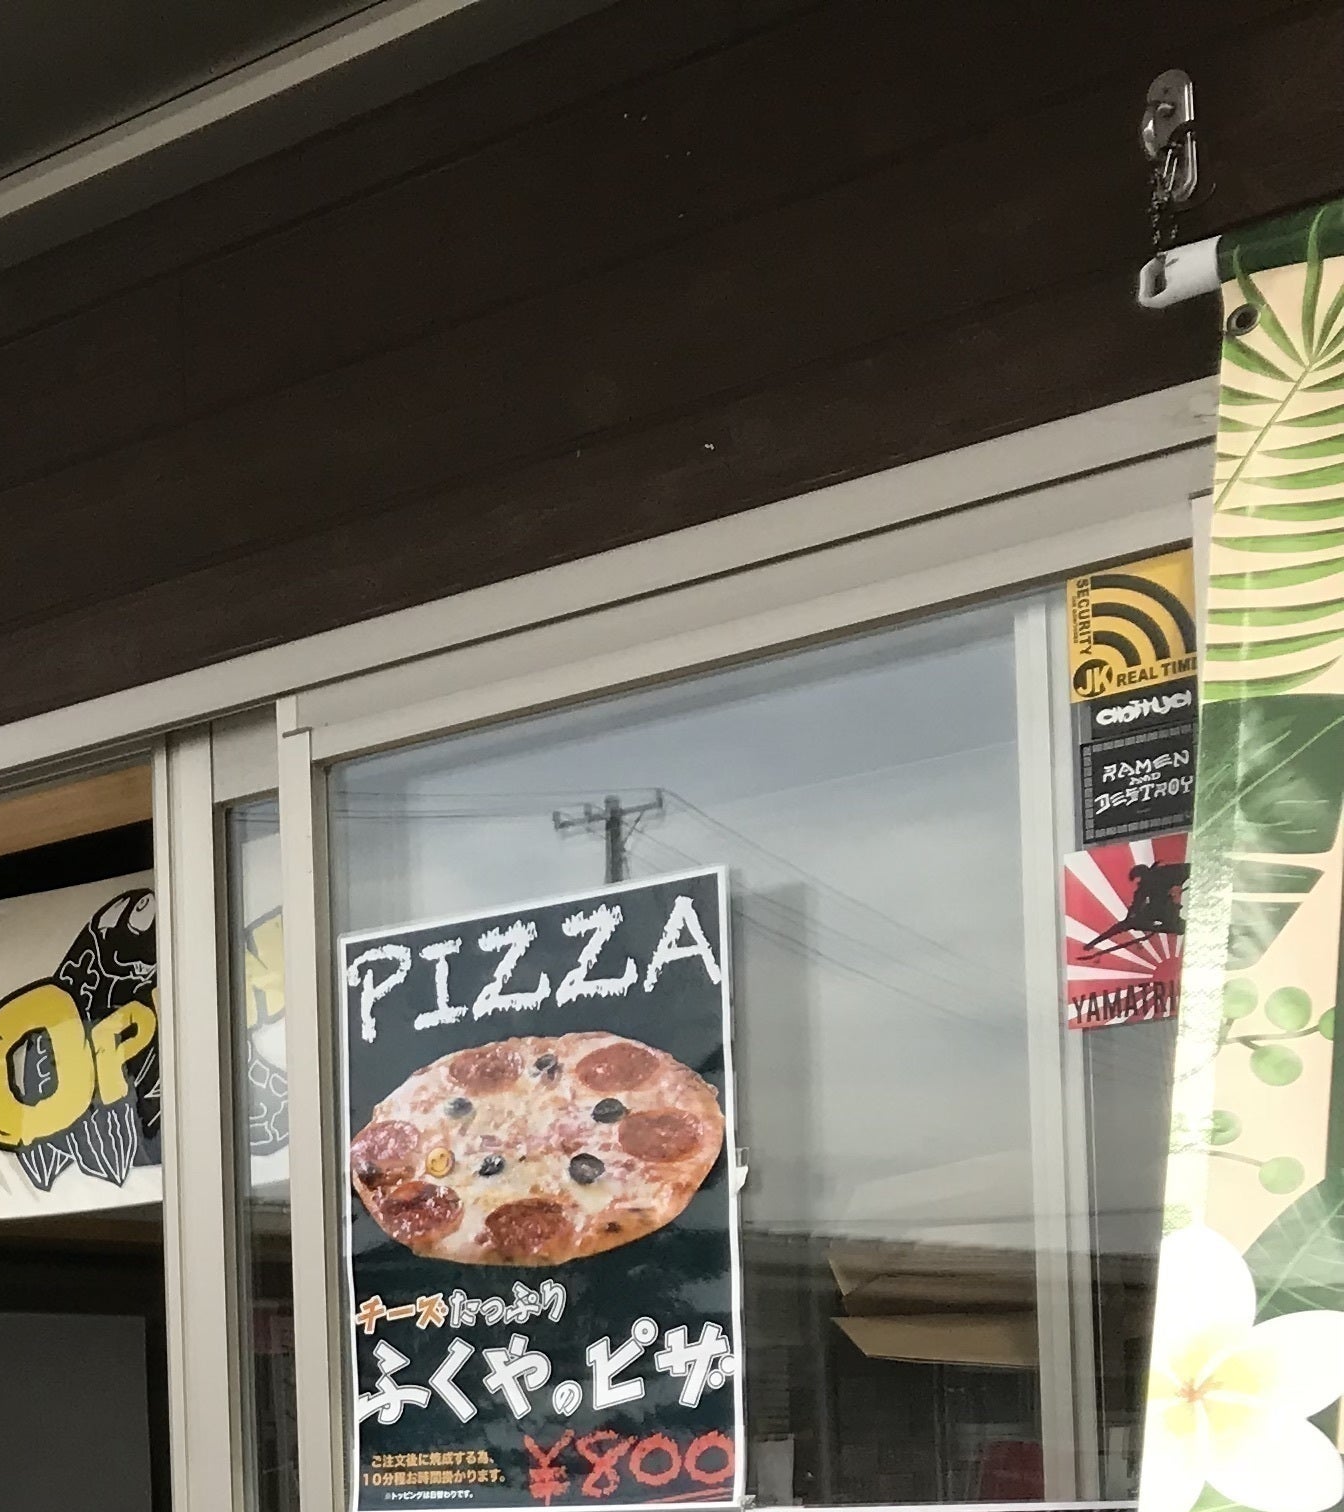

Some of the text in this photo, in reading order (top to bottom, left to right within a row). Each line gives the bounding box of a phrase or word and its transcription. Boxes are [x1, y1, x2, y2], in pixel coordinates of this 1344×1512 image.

[1076, 579, 1092, 656] SECURITY
[1116, 667, 1158, 688] REAL
[1094, 775, 1193, 815] DESTROY
[1102, 750, 1189, 783] RAMEN
[347, 895, 722, 1044] PIZZA
[356, 1278, 567, 1335] チーズたっぷり
[358, 1318, 736, 1424] ふくやのピザ
